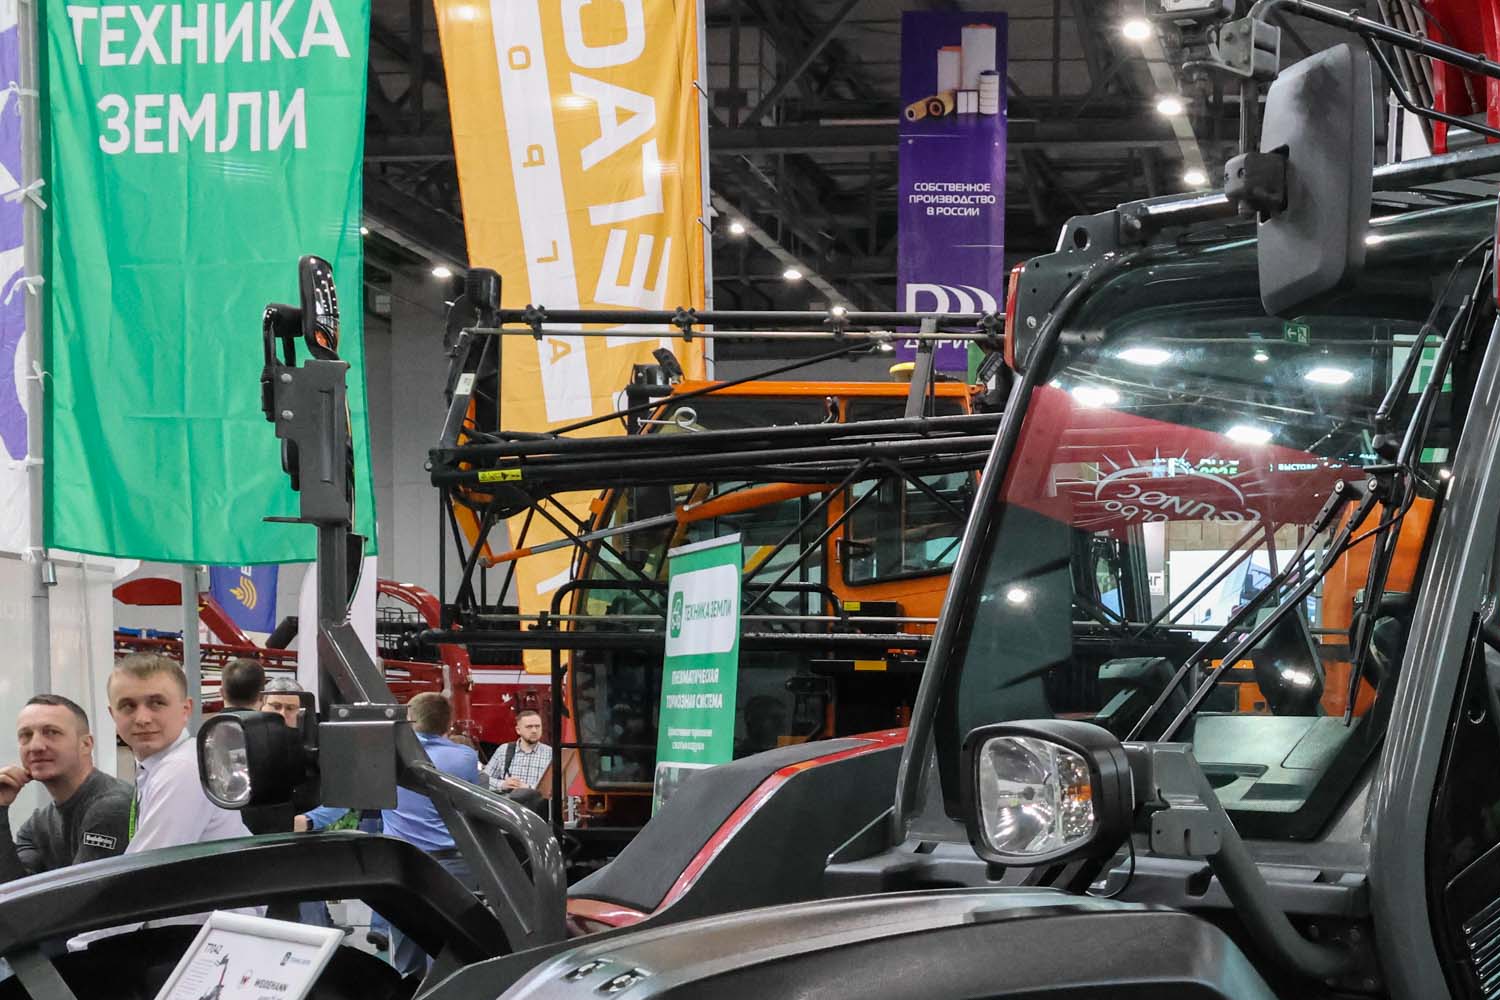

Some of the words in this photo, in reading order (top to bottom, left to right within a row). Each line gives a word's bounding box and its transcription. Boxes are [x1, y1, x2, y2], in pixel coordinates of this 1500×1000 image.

[67, 0, 351, 66] ТЕХНИКА
[96, 88, 307, 154] ЗЕМЛИ
[914, 182, 991, 192] СОБСТВЕННОЕ
[908, 194, 996, 204] ПРОИЗВОДСТВО
[926, 207, 935, 216] В
[936, 207, 980, 216] РОССИИ
